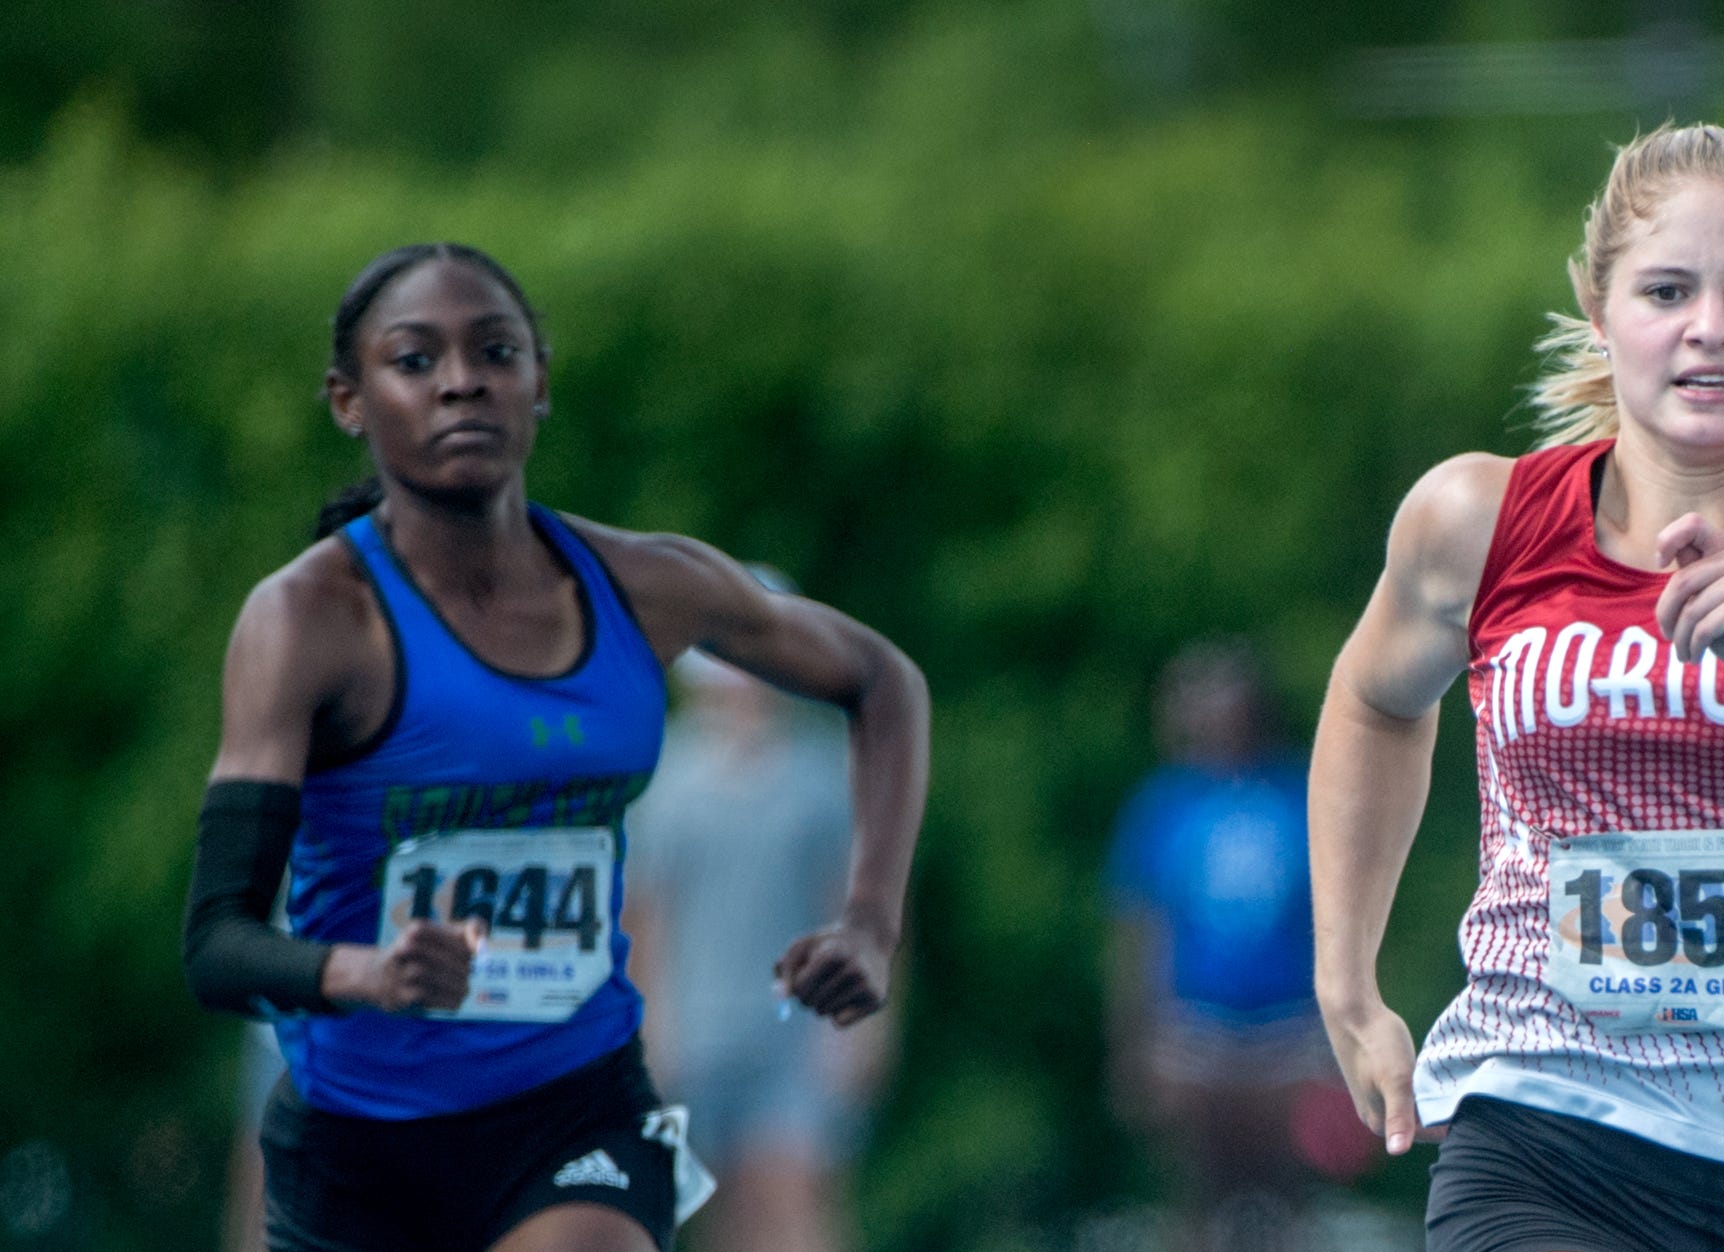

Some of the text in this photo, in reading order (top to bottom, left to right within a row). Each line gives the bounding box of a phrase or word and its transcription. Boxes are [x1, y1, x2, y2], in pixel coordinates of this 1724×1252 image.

[402, 864, 601, 952] 1644
[1589, 976, 1662, 994] CLASS
[1670, 977, 1698, 994] 2A
